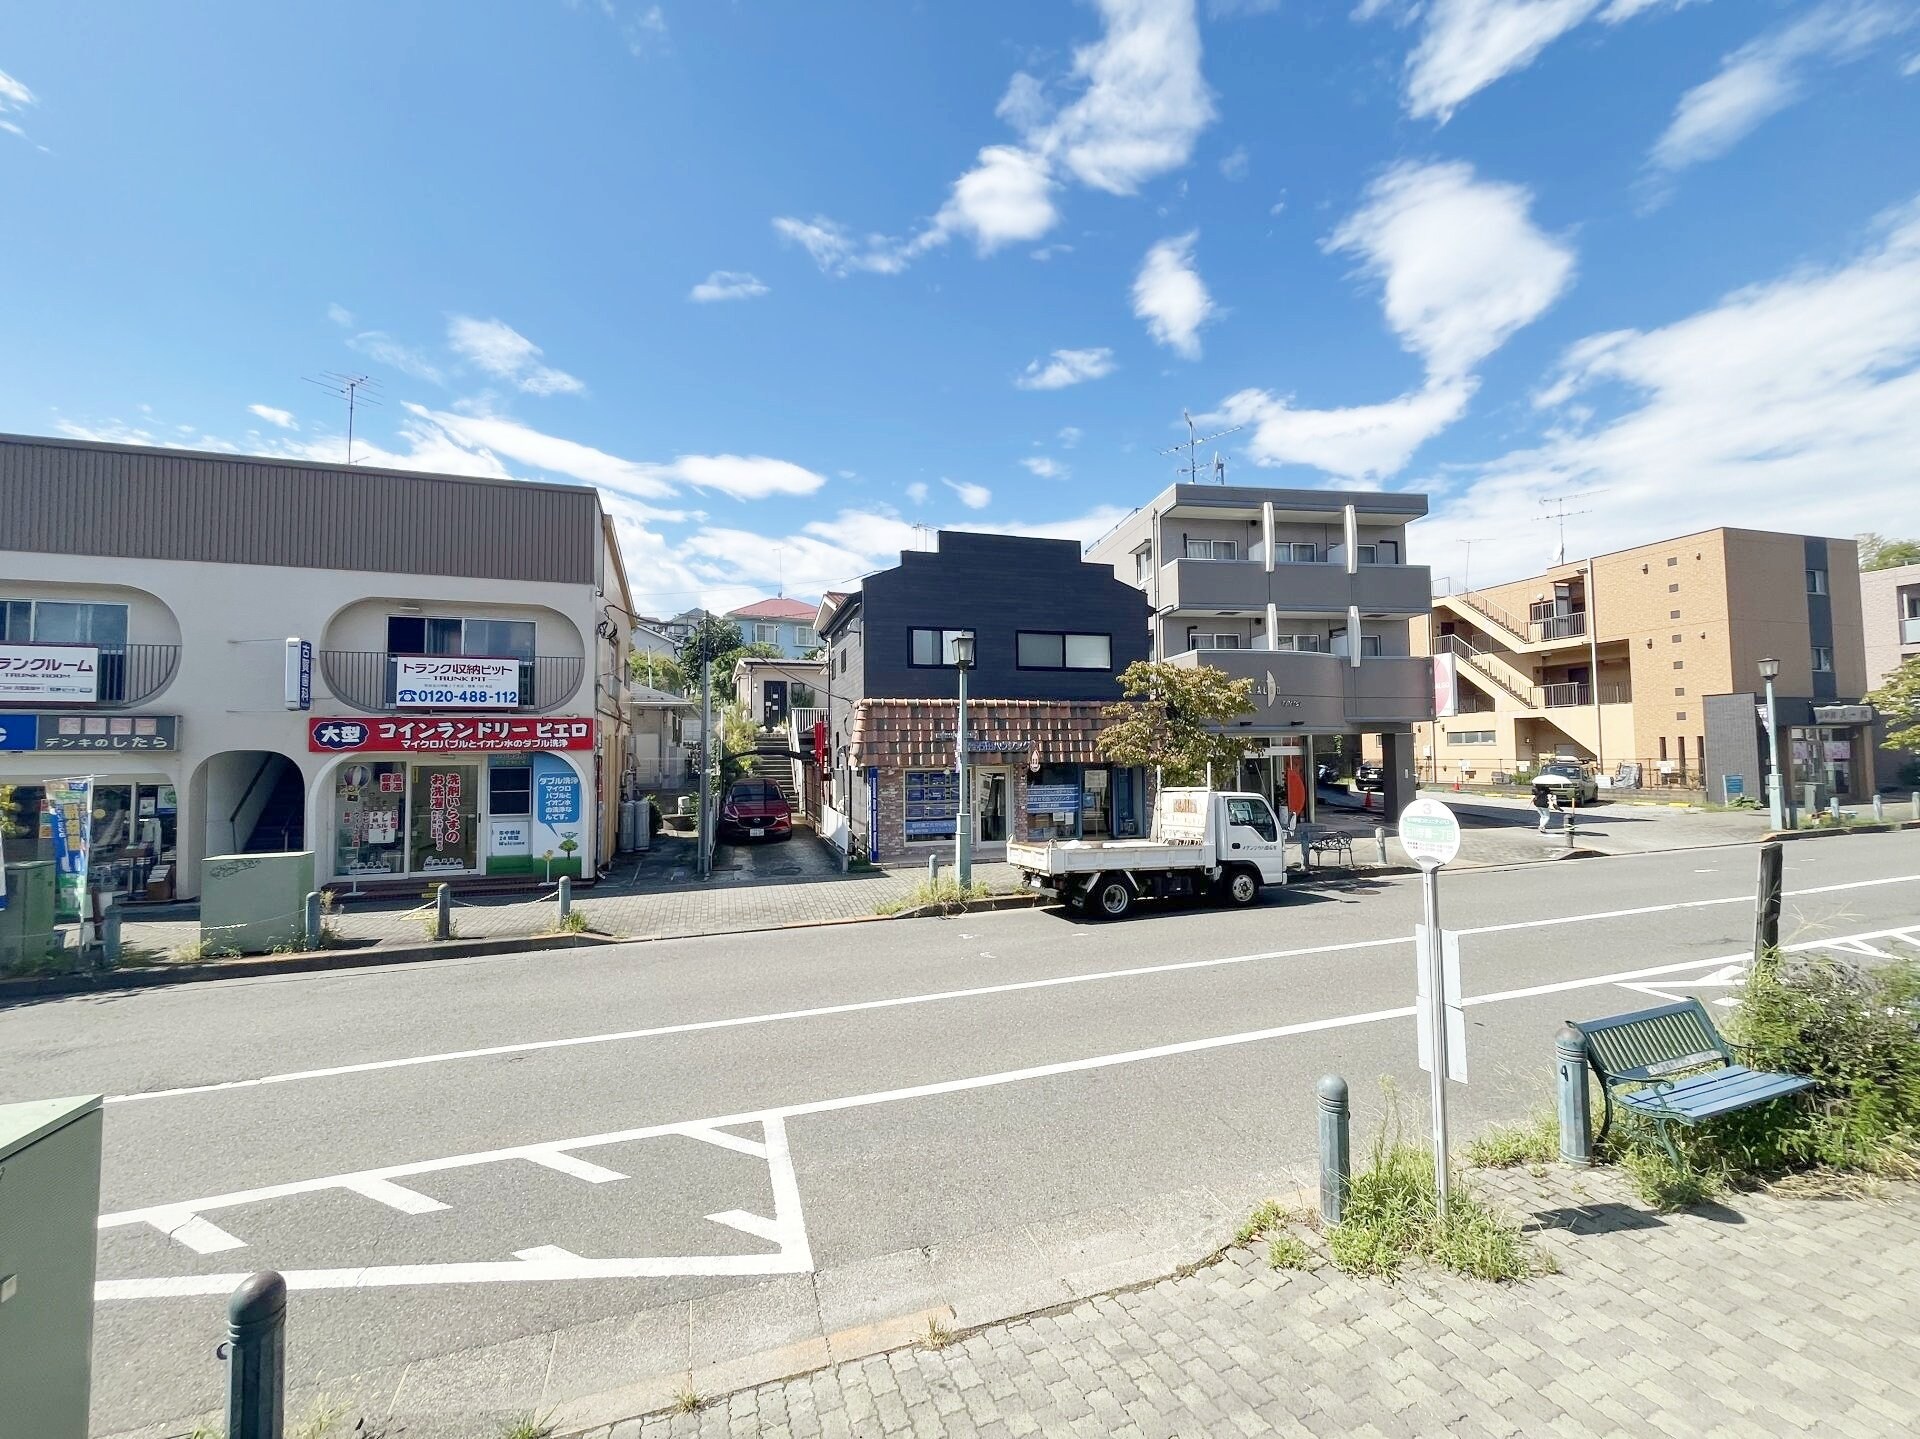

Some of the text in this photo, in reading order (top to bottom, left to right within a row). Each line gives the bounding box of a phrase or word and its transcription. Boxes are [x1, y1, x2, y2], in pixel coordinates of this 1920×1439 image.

[403, 663, 513, 676] トランク収納ピット
[418, 690, 517, 703] 0120-488-112
[321, 725, 360, 743] 大型
[378, 722, 588, 739] コインランドリー ピエロ
[1423, 803, 1432, 815] 3
